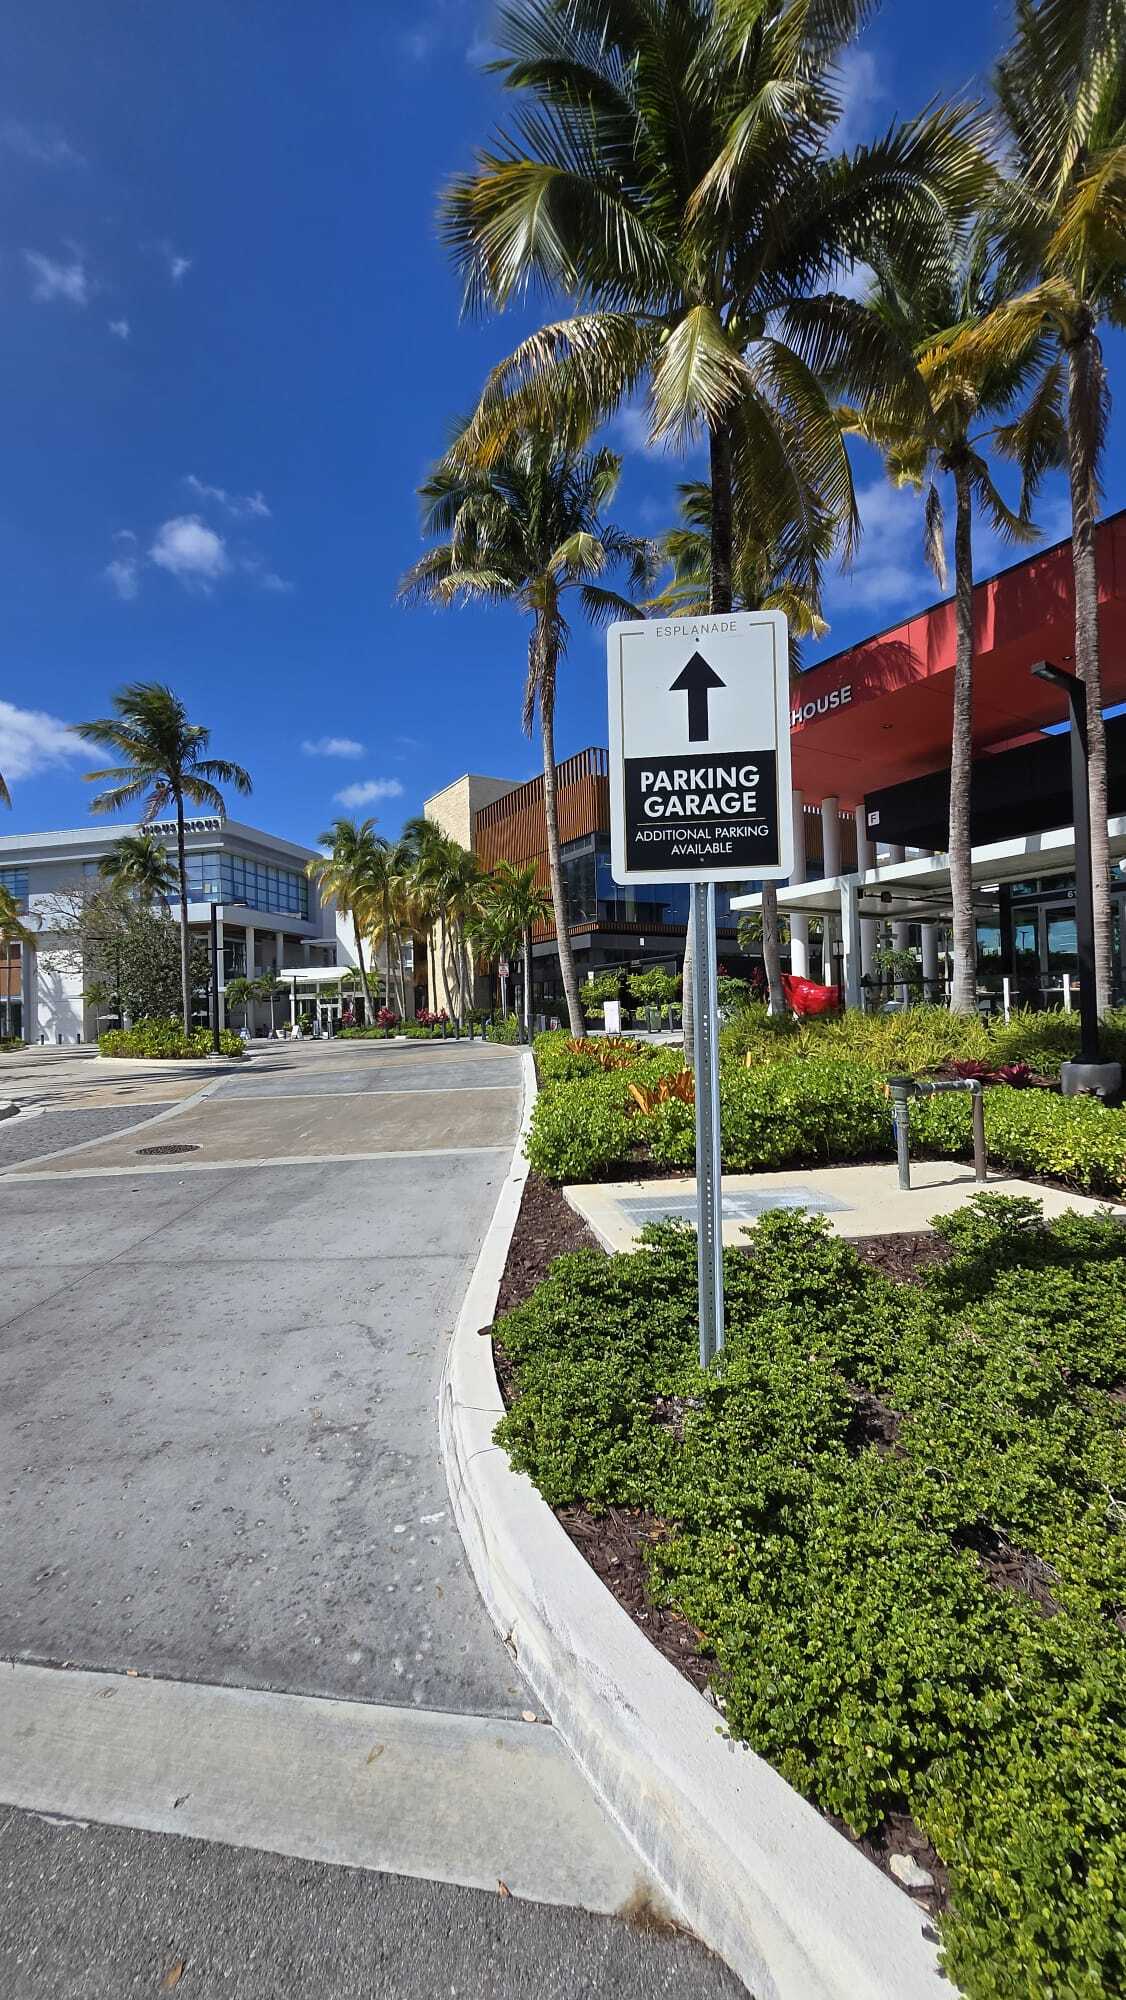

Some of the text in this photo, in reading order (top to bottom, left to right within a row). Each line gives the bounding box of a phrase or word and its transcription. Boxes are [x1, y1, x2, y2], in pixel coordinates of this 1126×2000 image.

[656, 621, 737, 638] ESPLANADE
[789, 685, 852, 728] HOUSE
[641, 766, 760, 792] PARKING
[644, 792, 757, 817] GARAGE
[635, 825, 769, 842] ADDITIONAL PARKING
[671, 842, 733, 855] AVAILABLE
